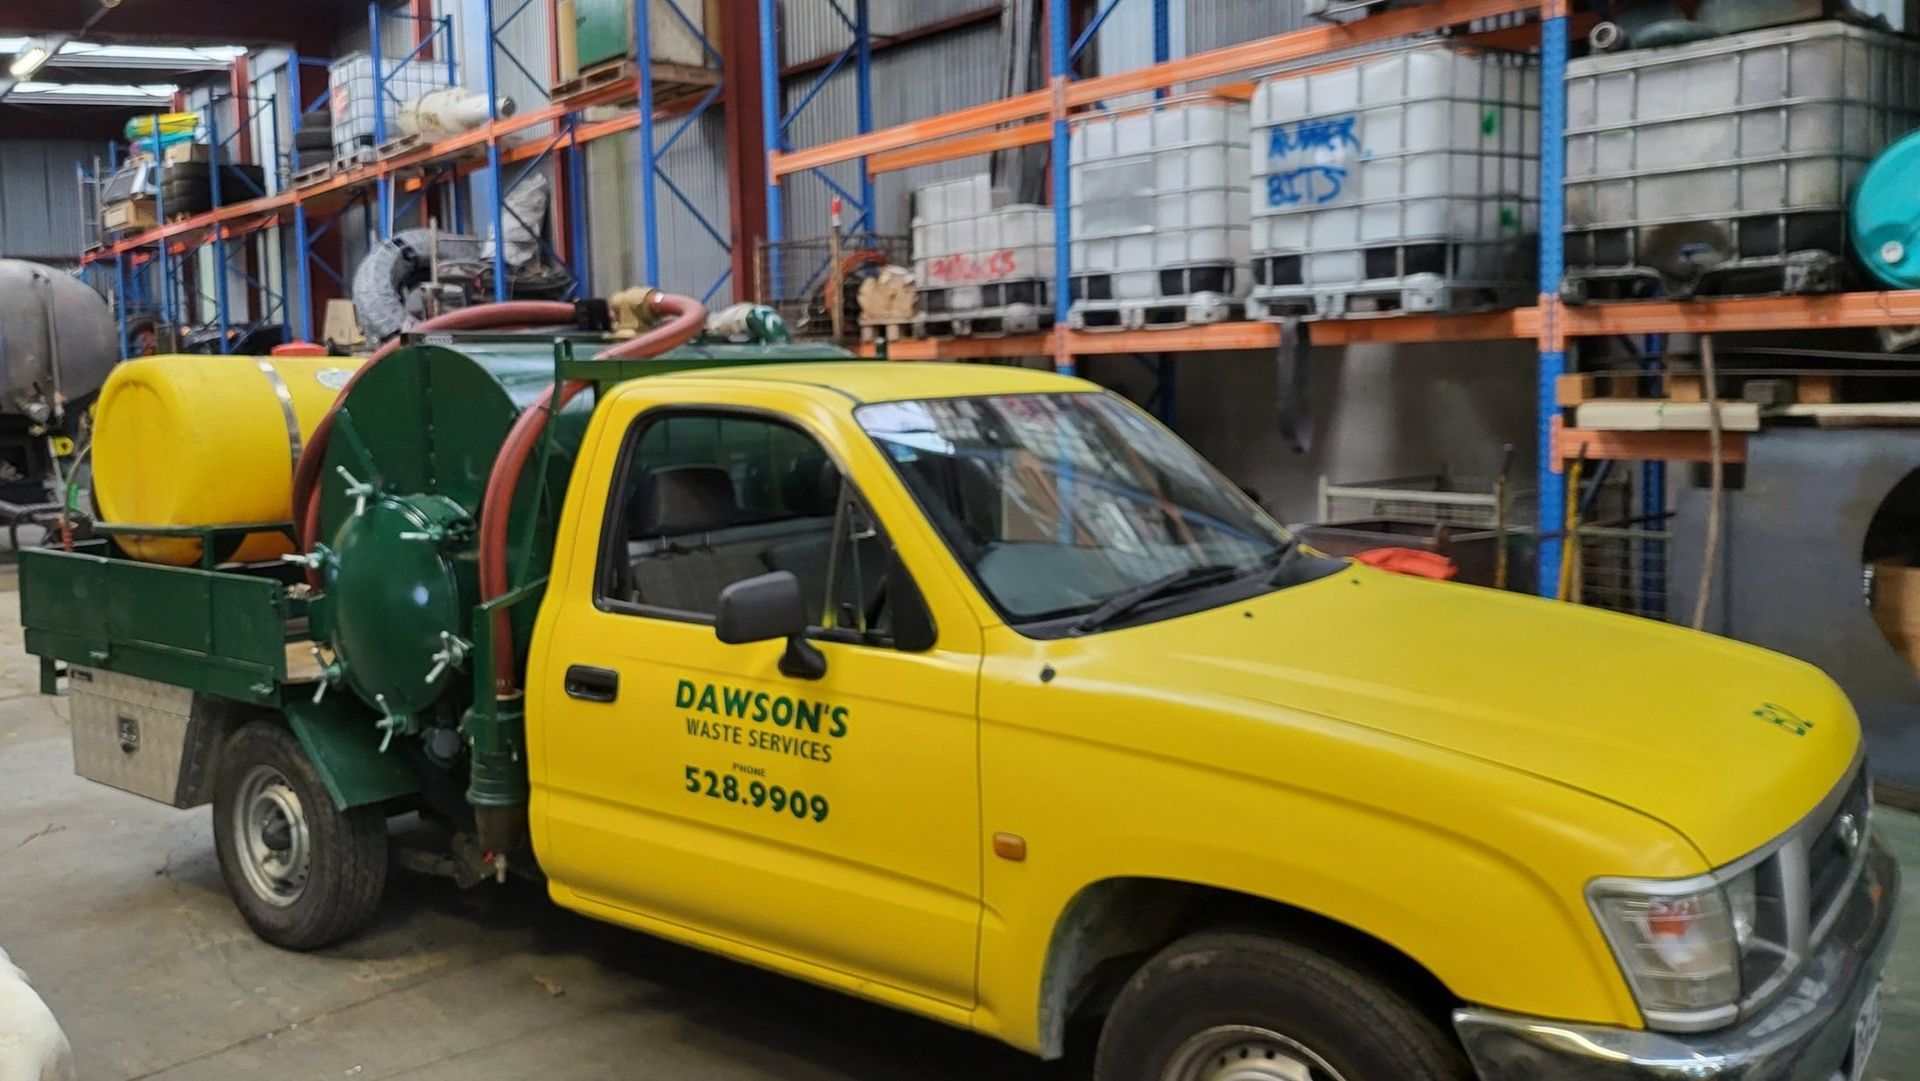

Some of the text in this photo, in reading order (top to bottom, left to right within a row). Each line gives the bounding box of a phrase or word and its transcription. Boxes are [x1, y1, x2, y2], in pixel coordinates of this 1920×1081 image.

[1267, 166, 1347, 207] BITS
[676, 680, 848, 738] DAWSON'S
[686, 717, 832, 763] WASTE SERVICES
[732, 762, 767, 777] PHONE
[685, 765, 829, 823] 528.9909
